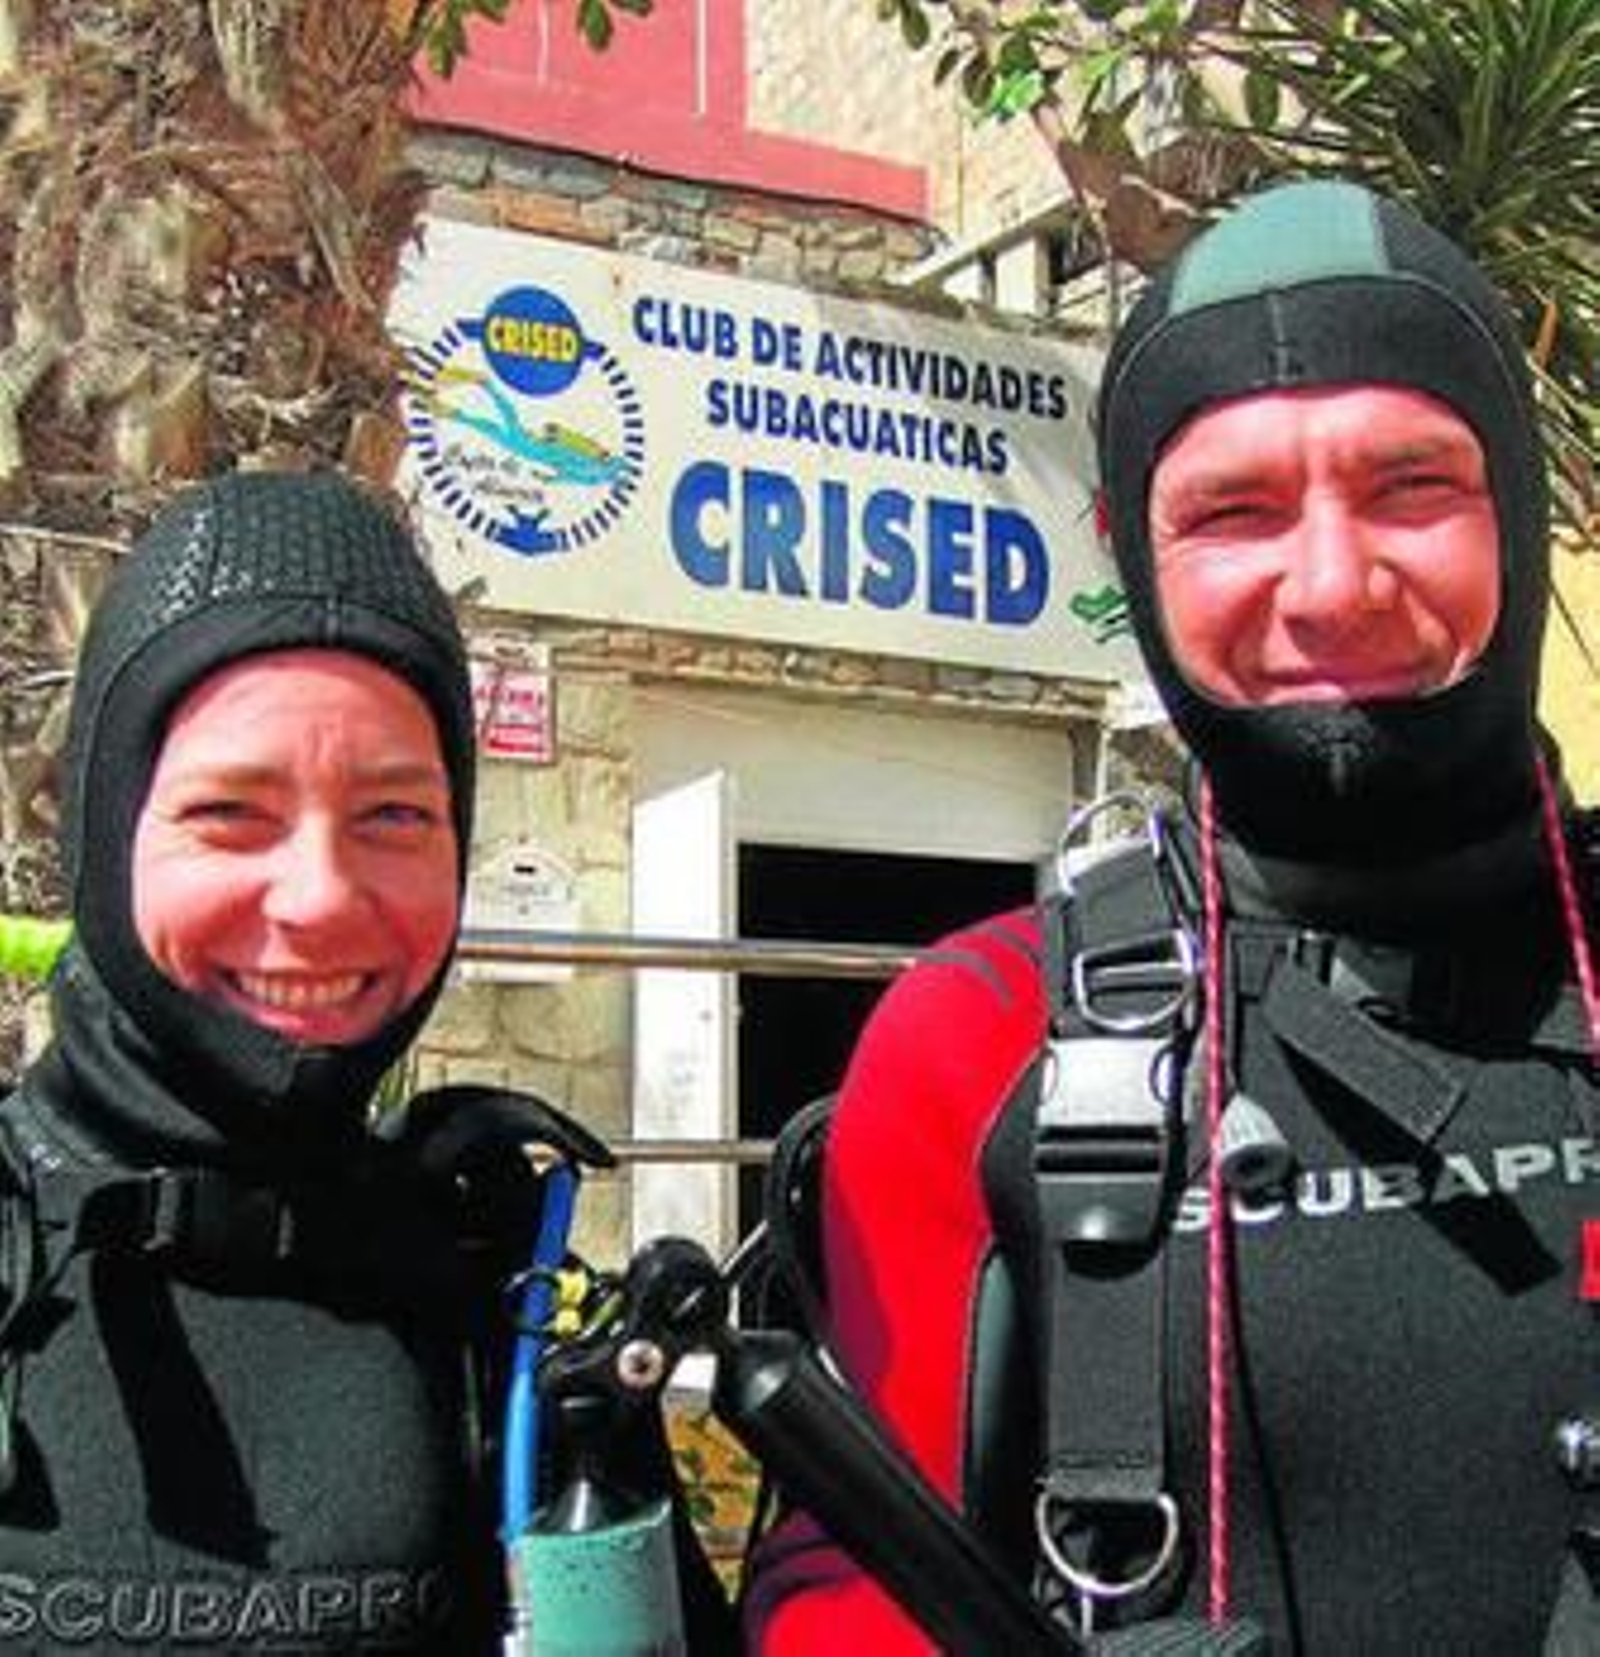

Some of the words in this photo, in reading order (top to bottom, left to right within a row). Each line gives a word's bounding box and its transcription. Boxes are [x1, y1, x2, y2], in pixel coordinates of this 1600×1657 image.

[486, 315, 579, 363] CRISED
[632, 296, 738, 360] CLUB
[752, 324, 803, 371] DE
[814, 335, 1068, 420] ACTIVIDADES
[706, 379, 1009, 475] SUBACUATICAS
[668, 459, 1052, 629] CRISED
